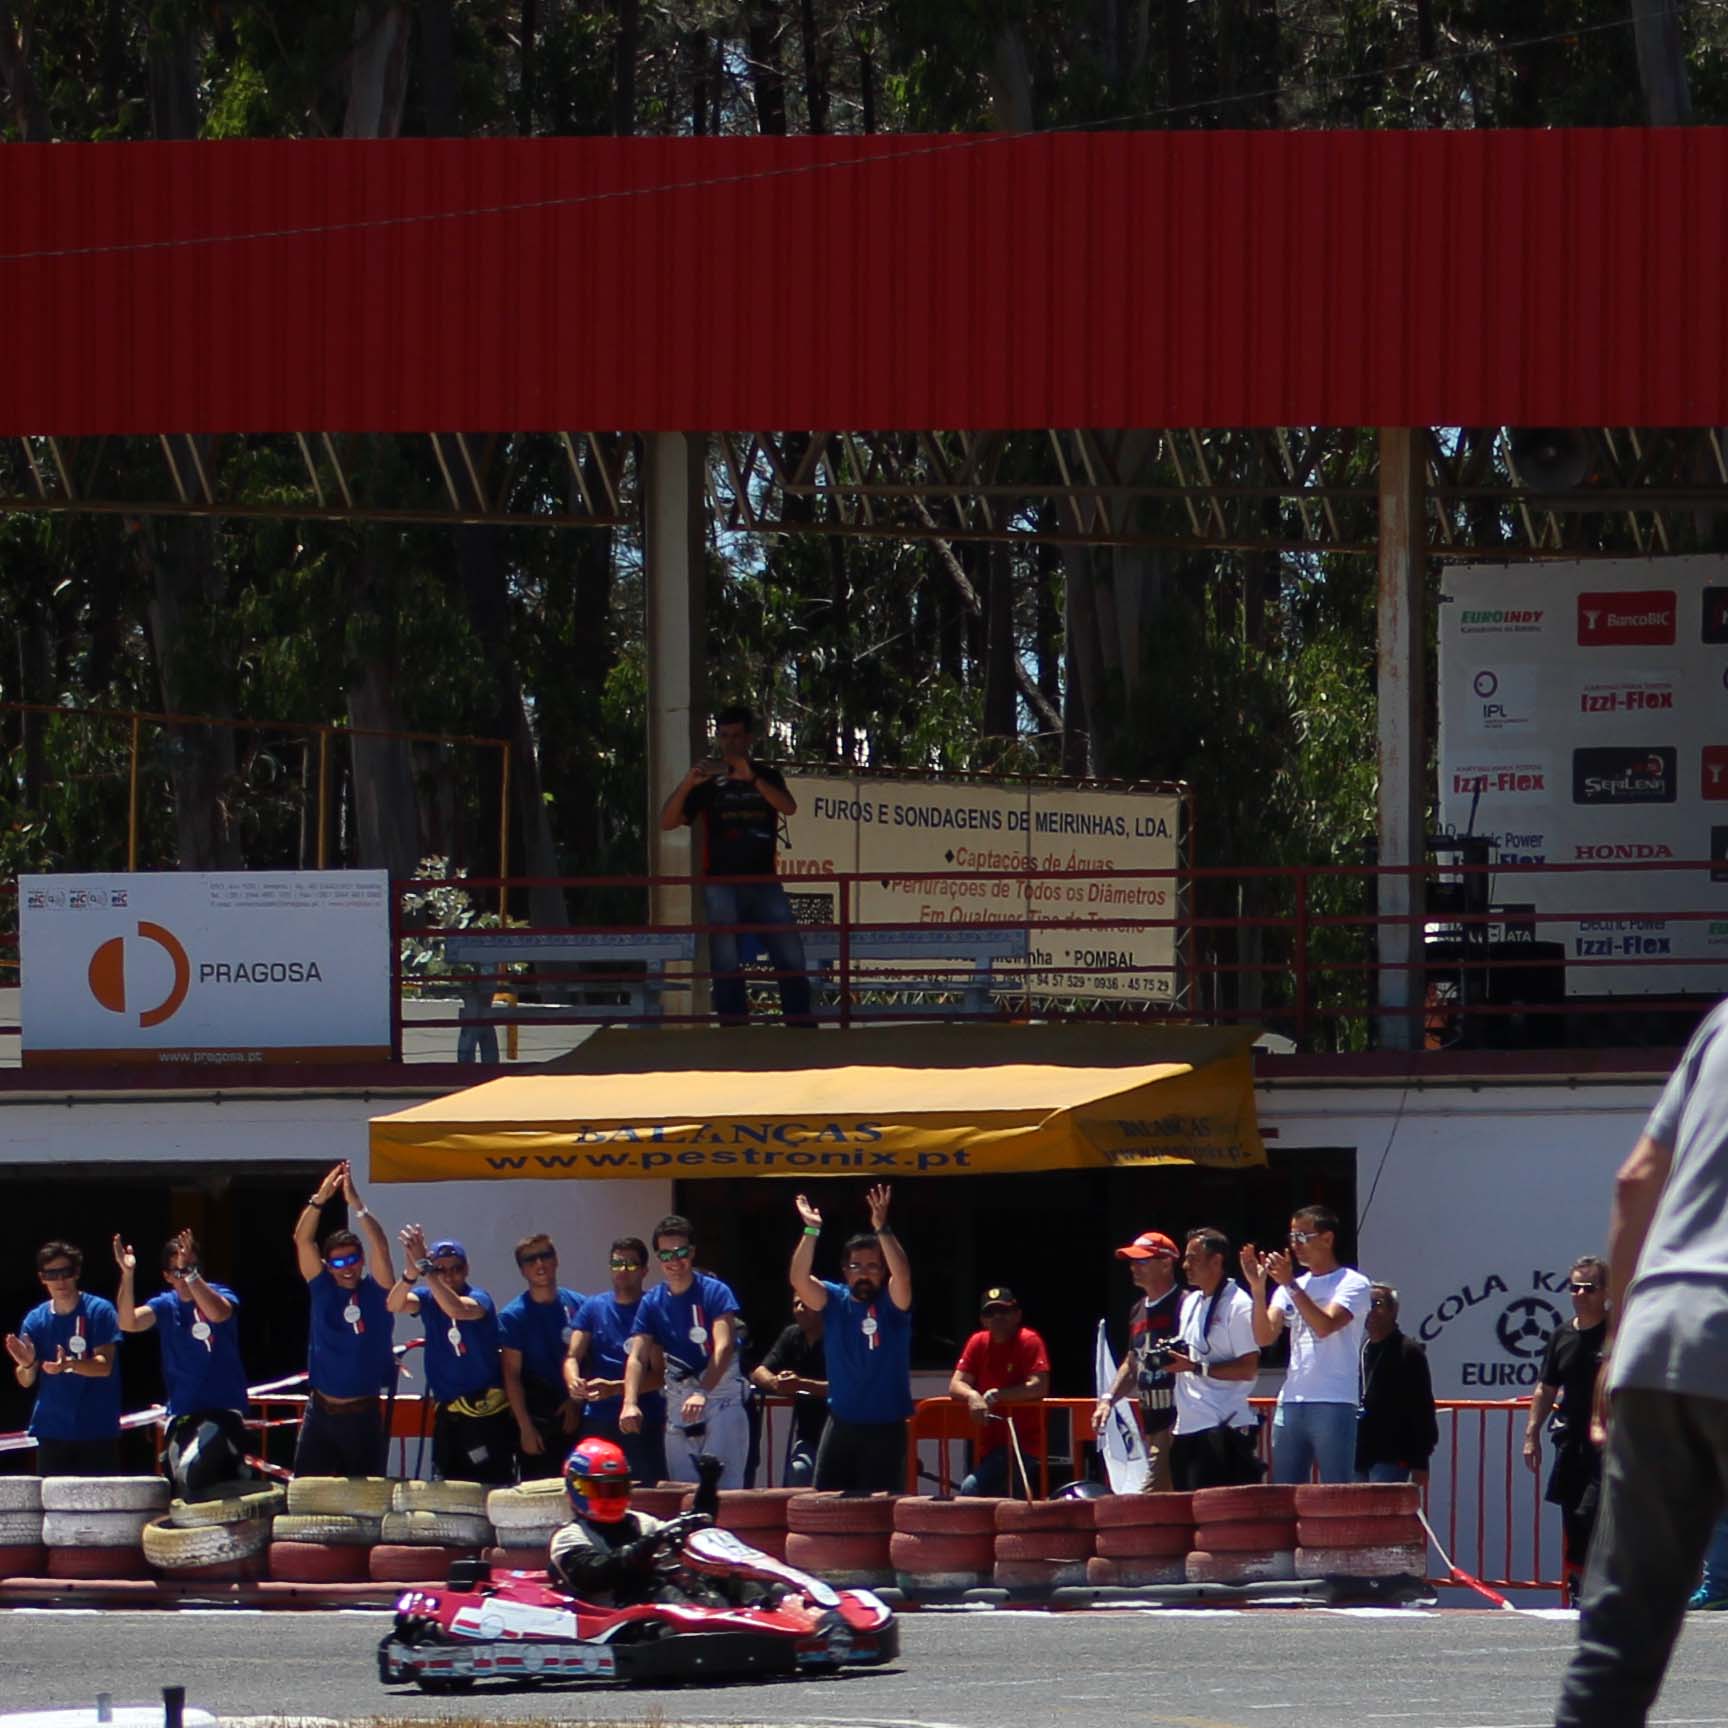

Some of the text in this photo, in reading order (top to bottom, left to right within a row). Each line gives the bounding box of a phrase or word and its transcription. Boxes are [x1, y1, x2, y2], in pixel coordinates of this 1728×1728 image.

[1461, 610, 1543, 624] EUROINDY
[1607, 612, 1670, 628] BancoBIC
[814, 797, 1173, 839] FUROS E SONDAGENS DE MEIRINHAS, LDA.
[956, 847, 1038, 873] Captações
[1575, 844, 1673, 860] HONDA
[1066, 886, 1084, 902] os
[1088, 884, 1166, 906] Diâmetros
[200, 962, 322, 983] PRAGOSA
[160, 1050, 263, 1064] www.pragosa.pt
[486, 1144, 972, 1173] www.pestronix.pt
